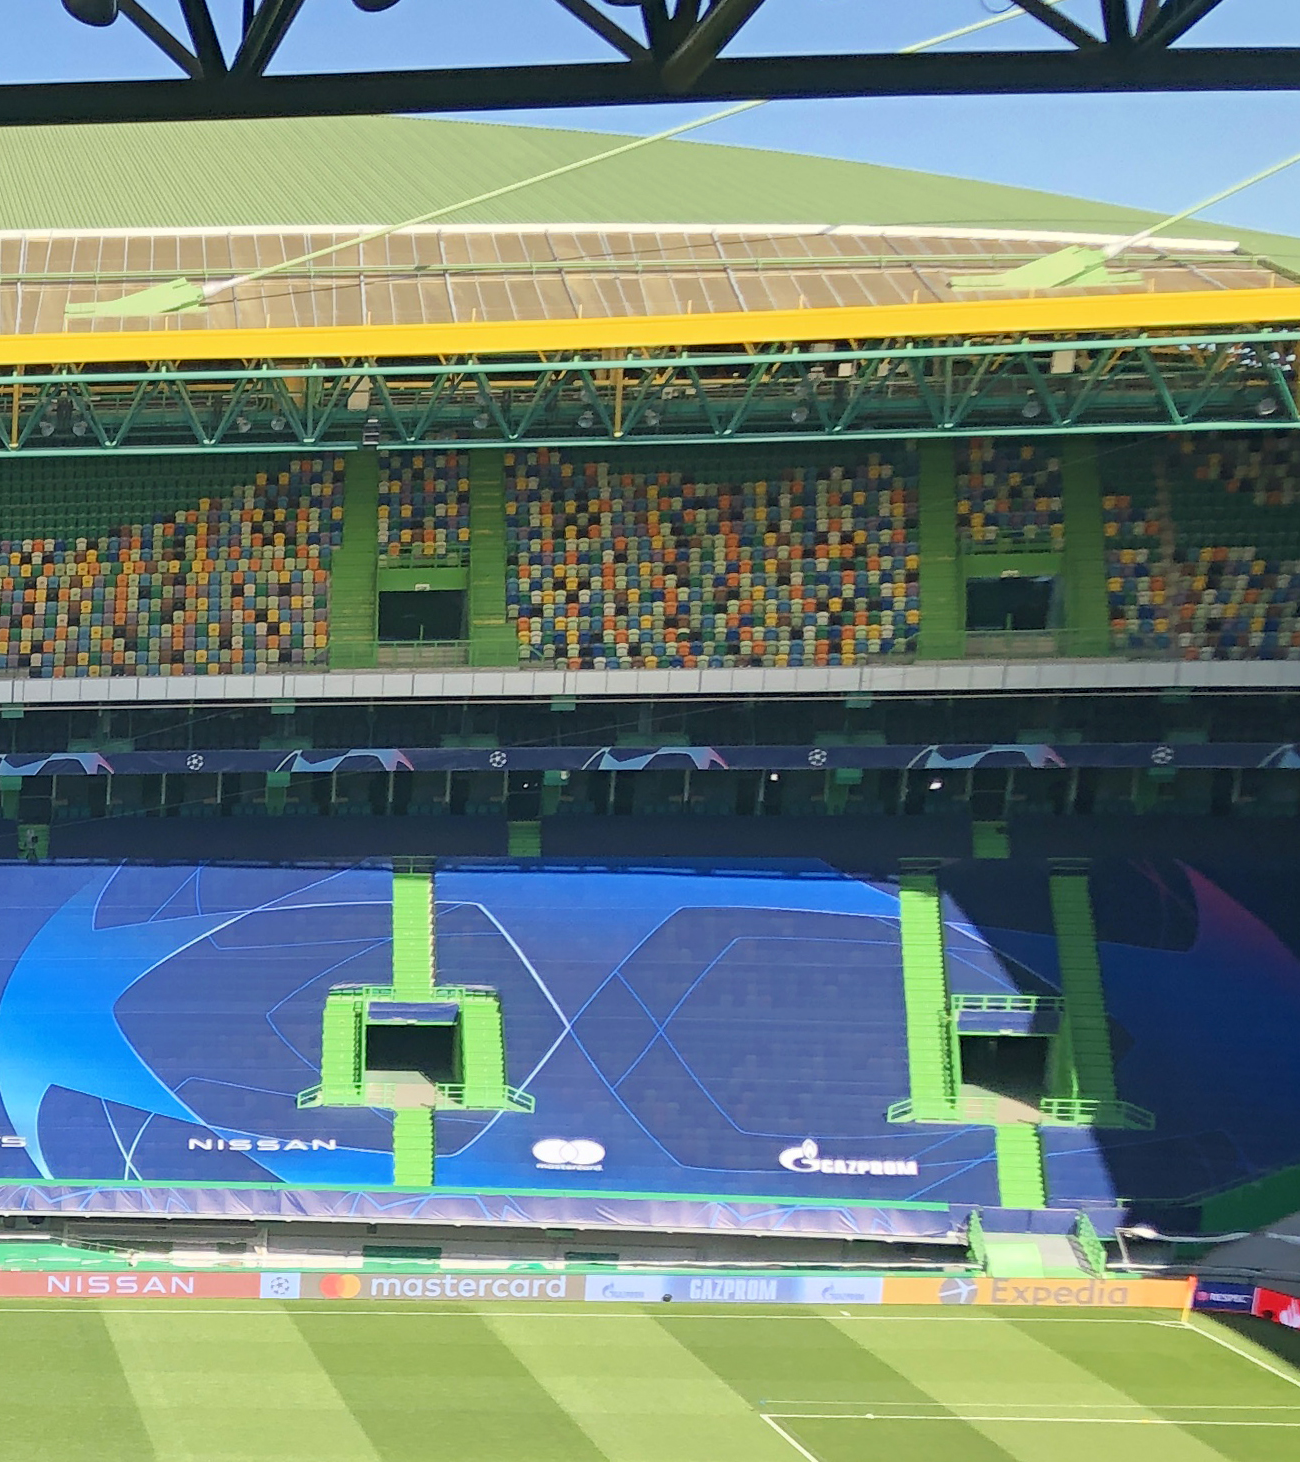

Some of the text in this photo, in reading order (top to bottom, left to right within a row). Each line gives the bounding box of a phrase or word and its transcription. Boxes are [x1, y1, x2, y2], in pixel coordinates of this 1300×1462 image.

[188, 1138, 336, 1151] NISSAN
[820, 1159, 918, 1175] GAZPROM
[47, 1275, 195, 1294] NISSAN
[371, 1274, 567, 1297] mastercard
[689, 1278, 777, 1300] GAZPROM
[991, 1278, 1129, 1305] Expedia
